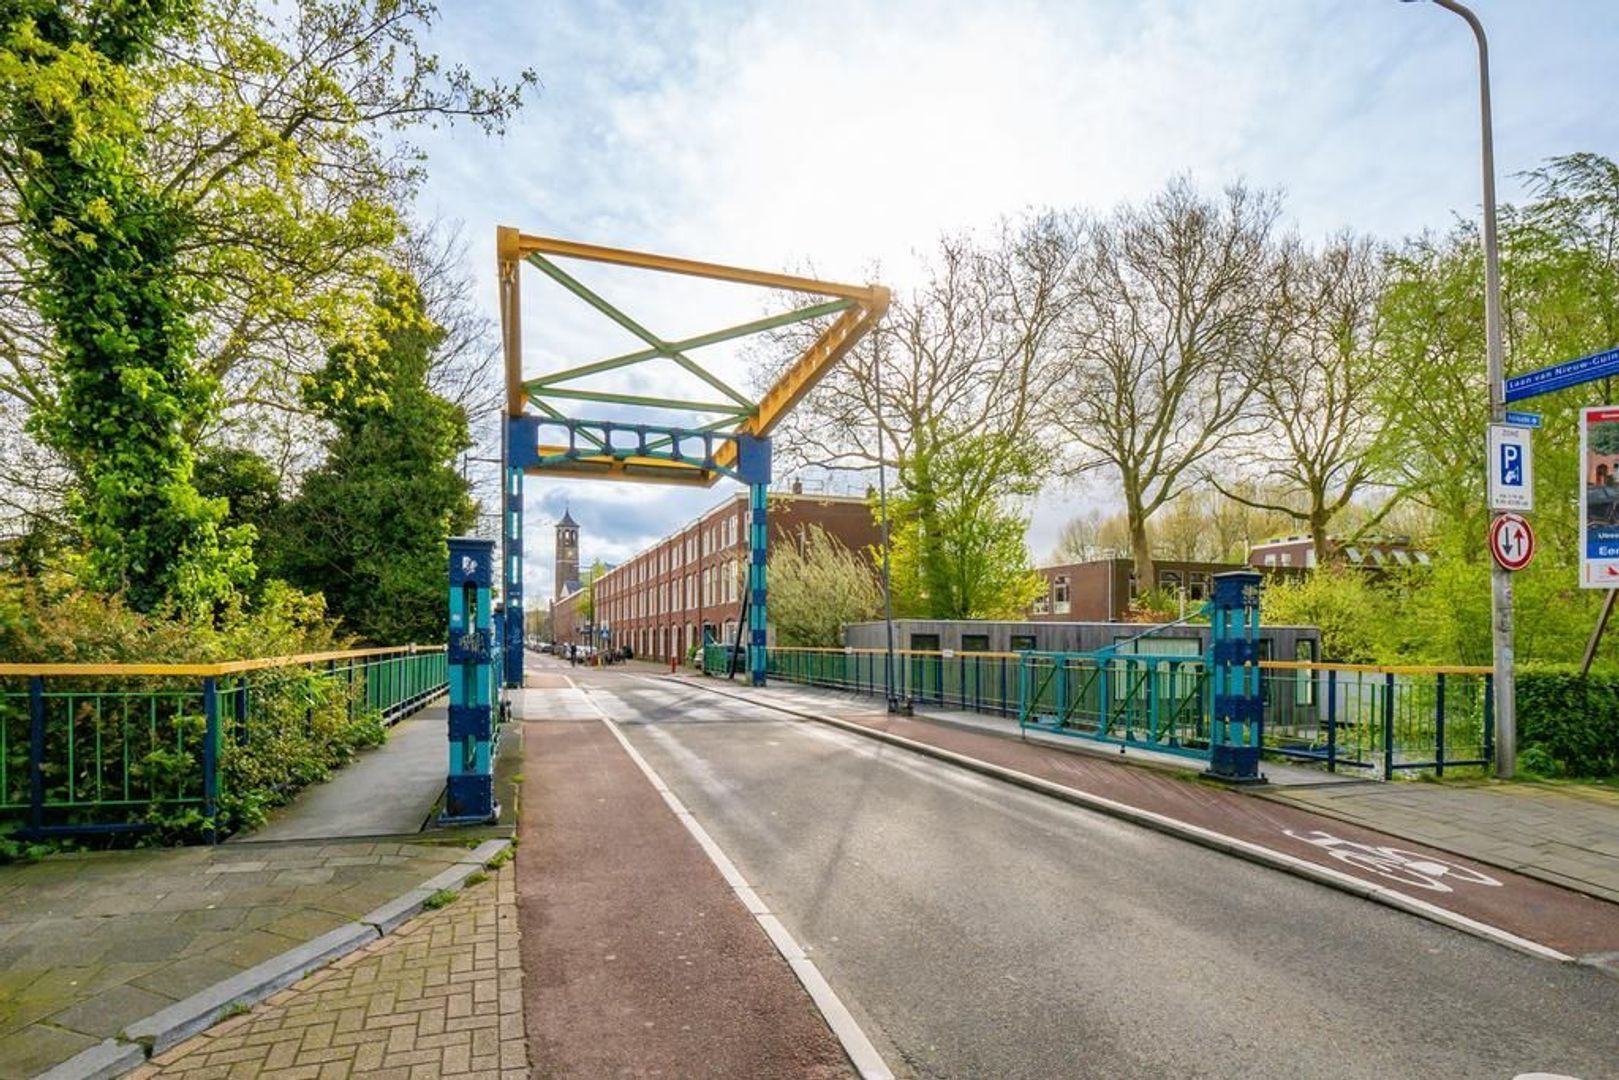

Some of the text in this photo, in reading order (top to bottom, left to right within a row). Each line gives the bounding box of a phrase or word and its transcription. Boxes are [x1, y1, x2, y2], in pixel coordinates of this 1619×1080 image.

[1509, 377, 1532, 388] Laan
[1534, 371, 1553, 381] van
[1504, 446, 1517, 469] P
